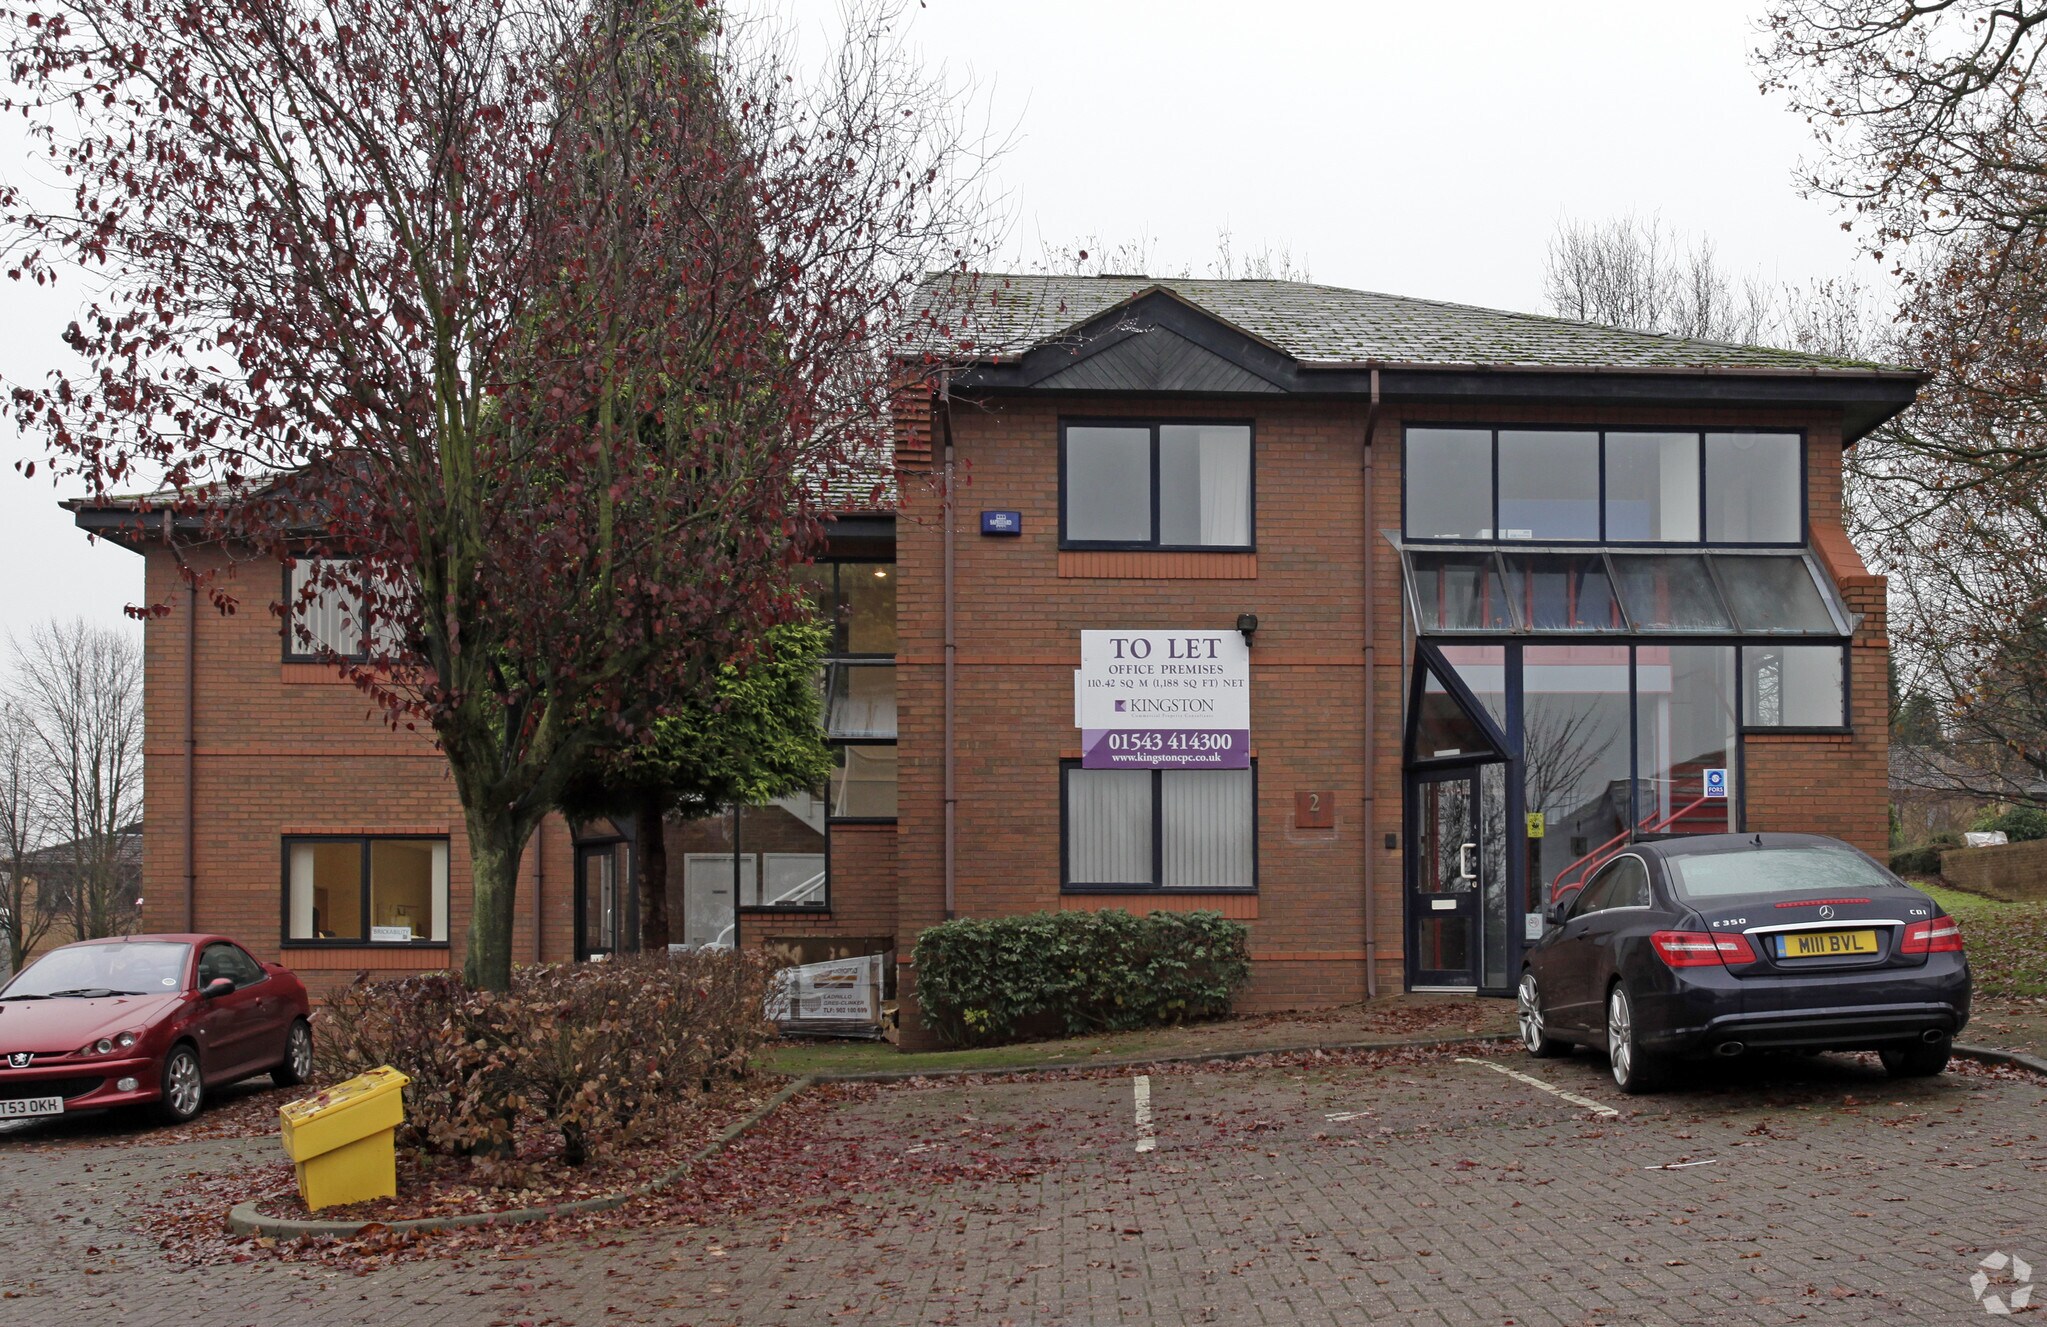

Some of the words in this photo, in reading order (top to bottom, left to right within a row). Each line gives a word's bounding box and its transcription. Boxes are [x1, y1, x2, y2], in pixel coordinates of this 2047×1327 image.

[1109, 637, 1152, 660] TO
[1167, 637, 1222, 660] LET
[1108, 664, 1154, 675] OFFICE
[1161, 664, 1224, 675] PREMISES
[1087, 679, 1115, 688] 110.42
[1120, 679, 1134, 689] SQ
[1139, 679, 1148, 688] M
[1153, 678, 1179, 689] (1,188
[1183, 679, 1197, 689] SQ
[1202, 678, 1218, 689] FT)
[1223, 679, 1245, 688] NET
[1130, 698, 1214, 712] KINGSTON
[1108, 732, 1163, 751] 01543
[1167, 732, 1232, 751] 414300
[1111, 752, 1222, 764] www.kingstoncpc.co.uk
[1309, 793, 1320, 812] 2
[1909, 908, 1927, 916] CDI
[1722, 918, 1747, 927] 350
[1829, 934, 1864, 952] BVL
[30, 1099, 57, 1113] OKH
